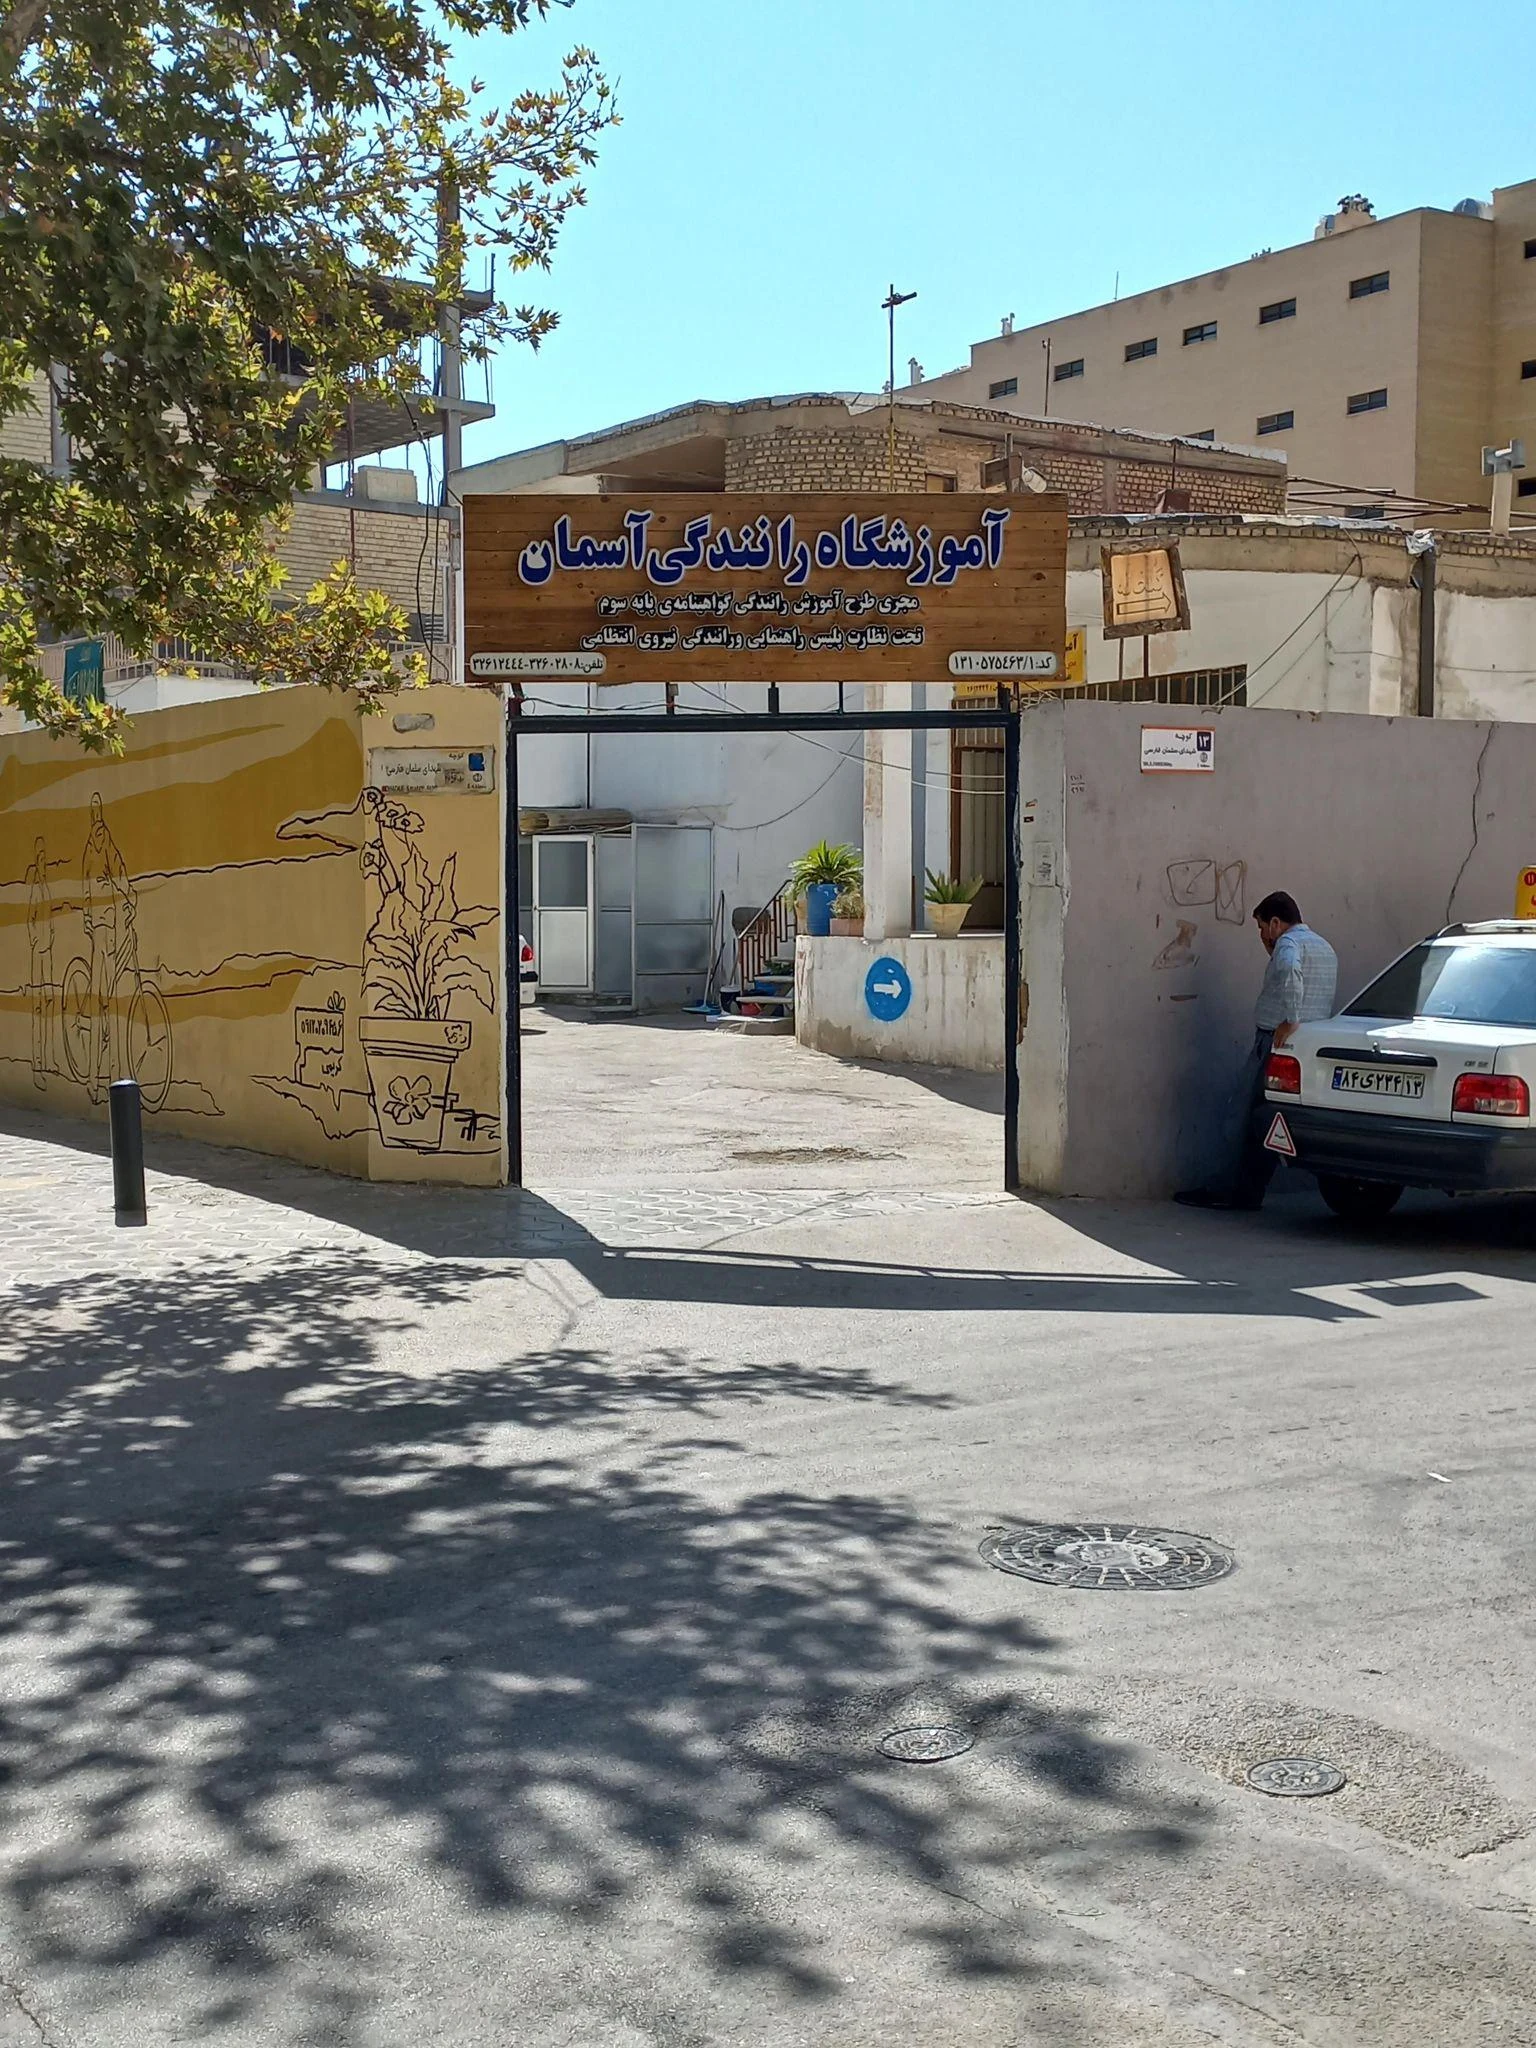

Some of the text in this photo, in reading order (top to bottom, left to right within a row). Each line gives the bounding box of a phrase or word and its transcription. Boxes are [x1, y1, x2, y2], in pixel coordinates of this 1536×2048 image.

[518, 508, 1010, 585] آموزشگاه رانندگی آسمان
[598, 594, 627, 616] سوم
[630, 589, 656, 616] پایه
[734, 590, 788, 615] رانندگی
[793, 589, 845, 615] آموزش
[844, 590, 877, 614] طرح
[878, 595, 919, 614] مجری
[581, 624, 635, 650] انتظامی
[638, 625, 679, 650] نیروی
[747, 624, 806, 650] راهنمایی
[809, 625, 844, 650] پلیس
[847, 624, 888, 649] نظارت
[891, 625, 925, 645] تحت
[1198, 735, 1210, 748] ۱۳
